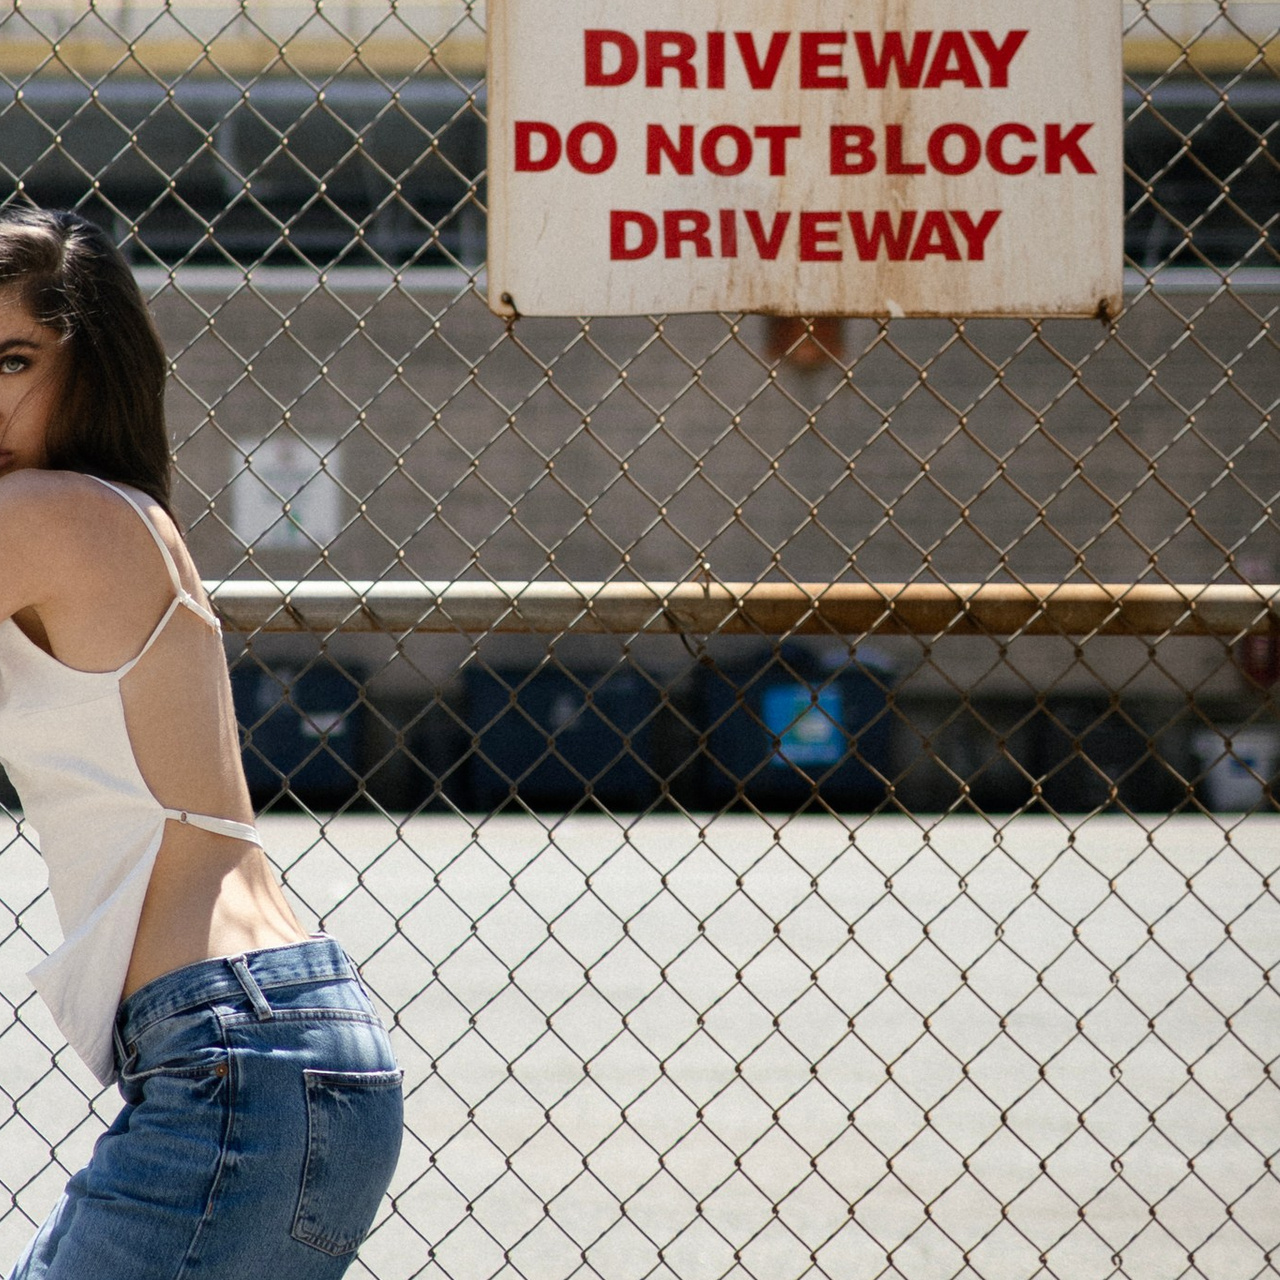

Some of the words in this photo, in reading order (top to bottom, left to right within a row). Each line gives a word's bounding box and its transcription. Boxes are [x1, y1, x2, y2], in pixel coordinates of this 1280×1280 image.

[583, 29, 1029, 90] DRIVEWAY
[513, 120, 617, 175] DO
[645, 123, 801, 176] NOT
[829, 122, 1097, 176] BLOCK
[609, 209, 1003, 262] DRIVEWAY
